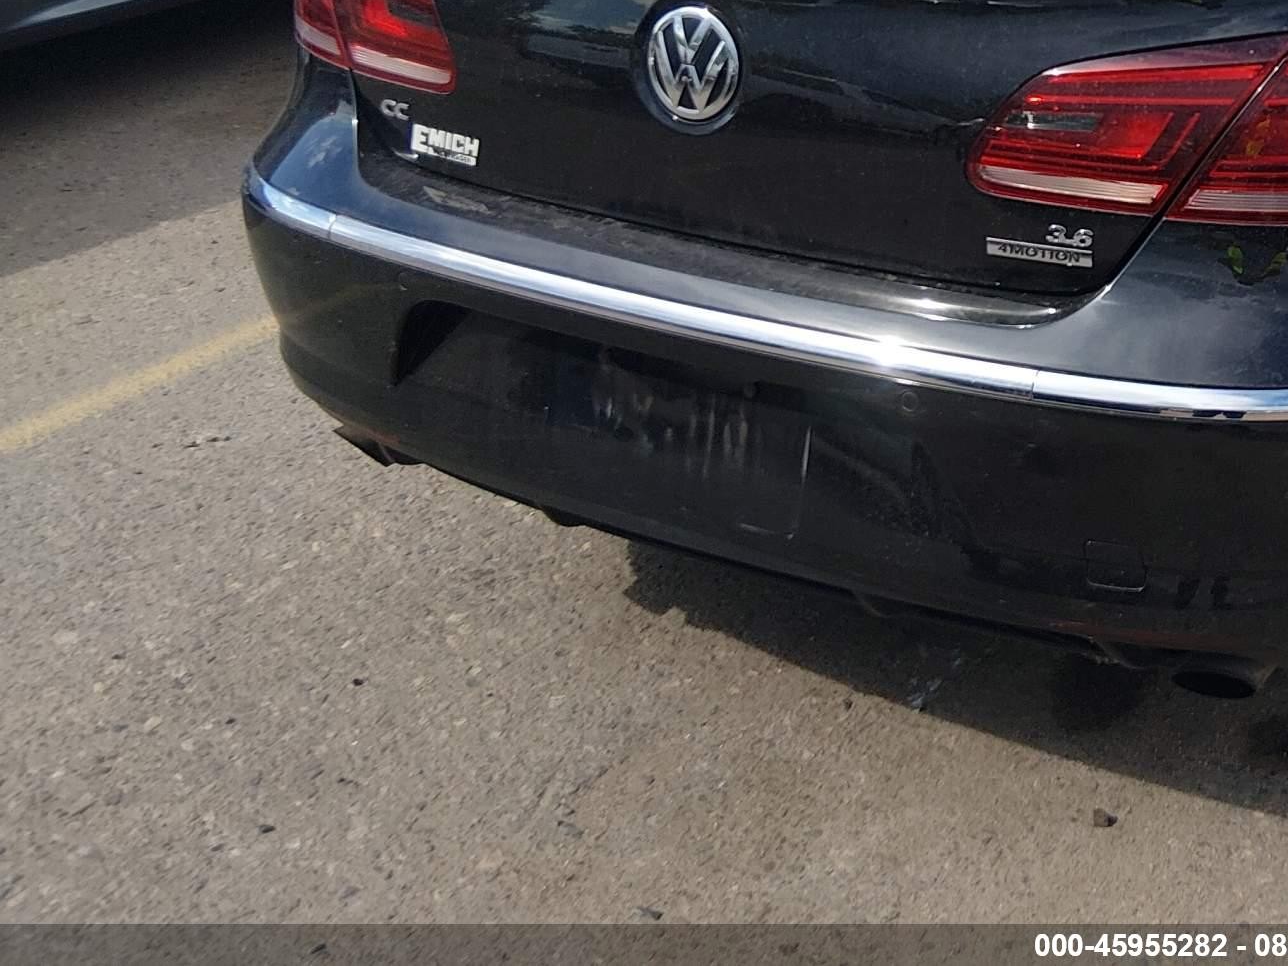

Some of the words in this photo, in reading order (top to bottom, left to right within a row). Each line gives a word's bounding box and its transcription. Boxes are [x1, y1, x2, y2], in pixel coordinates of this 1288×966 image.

[648, 6, 739, 121] VW
[380, 99, 410, 121] CC
[411, 123, 480, 157] EMICH
[1045, 224, 1094, 248] 3.6
[998, 242, 1081, 263] 4MOTION
